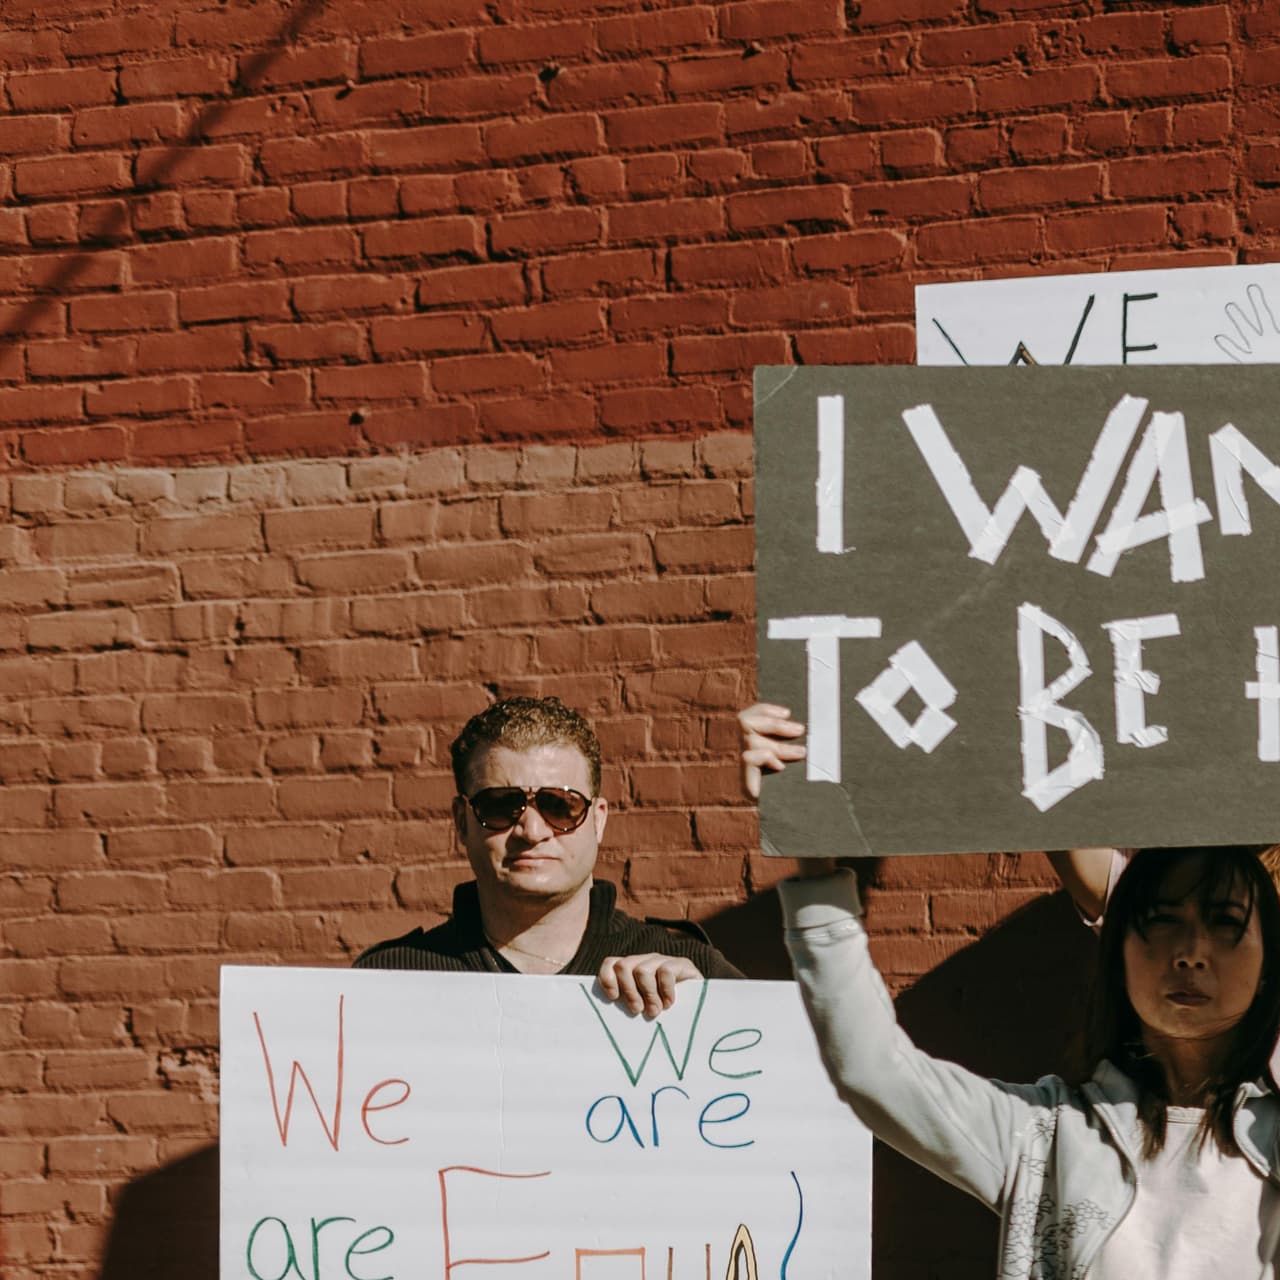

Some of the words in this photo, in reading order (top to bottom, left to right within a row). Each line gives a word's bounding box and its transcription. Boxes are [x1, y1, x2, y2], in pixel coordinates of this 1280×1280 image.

[816, 395, 846, 555] I
[767, 615, 958, 784] TO
[1018, 603, 1182, 812] BE
[252, 994, 411, 1151] We
[578, 978, 763, 1087] We
[585, 1086, 756, 1149] are
